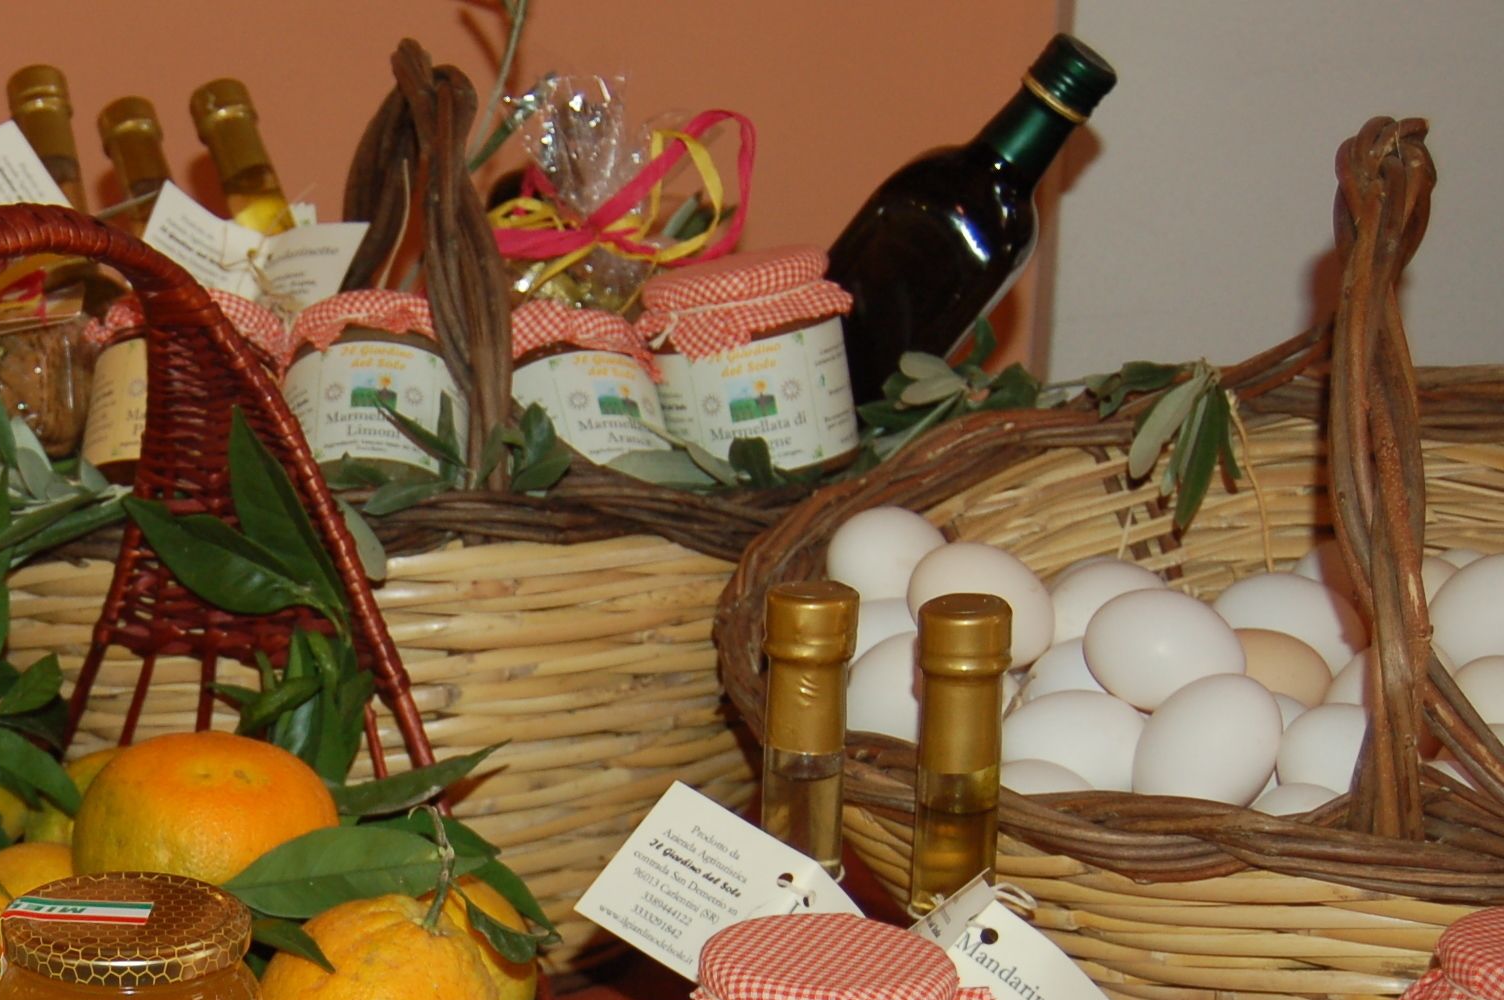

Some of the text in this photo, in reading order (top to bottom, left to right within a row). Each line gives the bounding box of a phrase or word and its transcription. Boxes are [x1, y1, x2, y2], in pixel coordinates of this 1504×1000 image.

[795, 411, 807, 425] di
[663, 828, 747, 884] Azienda Agrituristica
[691, 825, 740, 861] Prodotto da
[633, 850, 727, 910] contrada San Demetrio
[649, 838, 741, 898] Il Giardino del Sole
[659, 882, 700, 913] Carlentini
[700, 908, 719, 925] (SR)
